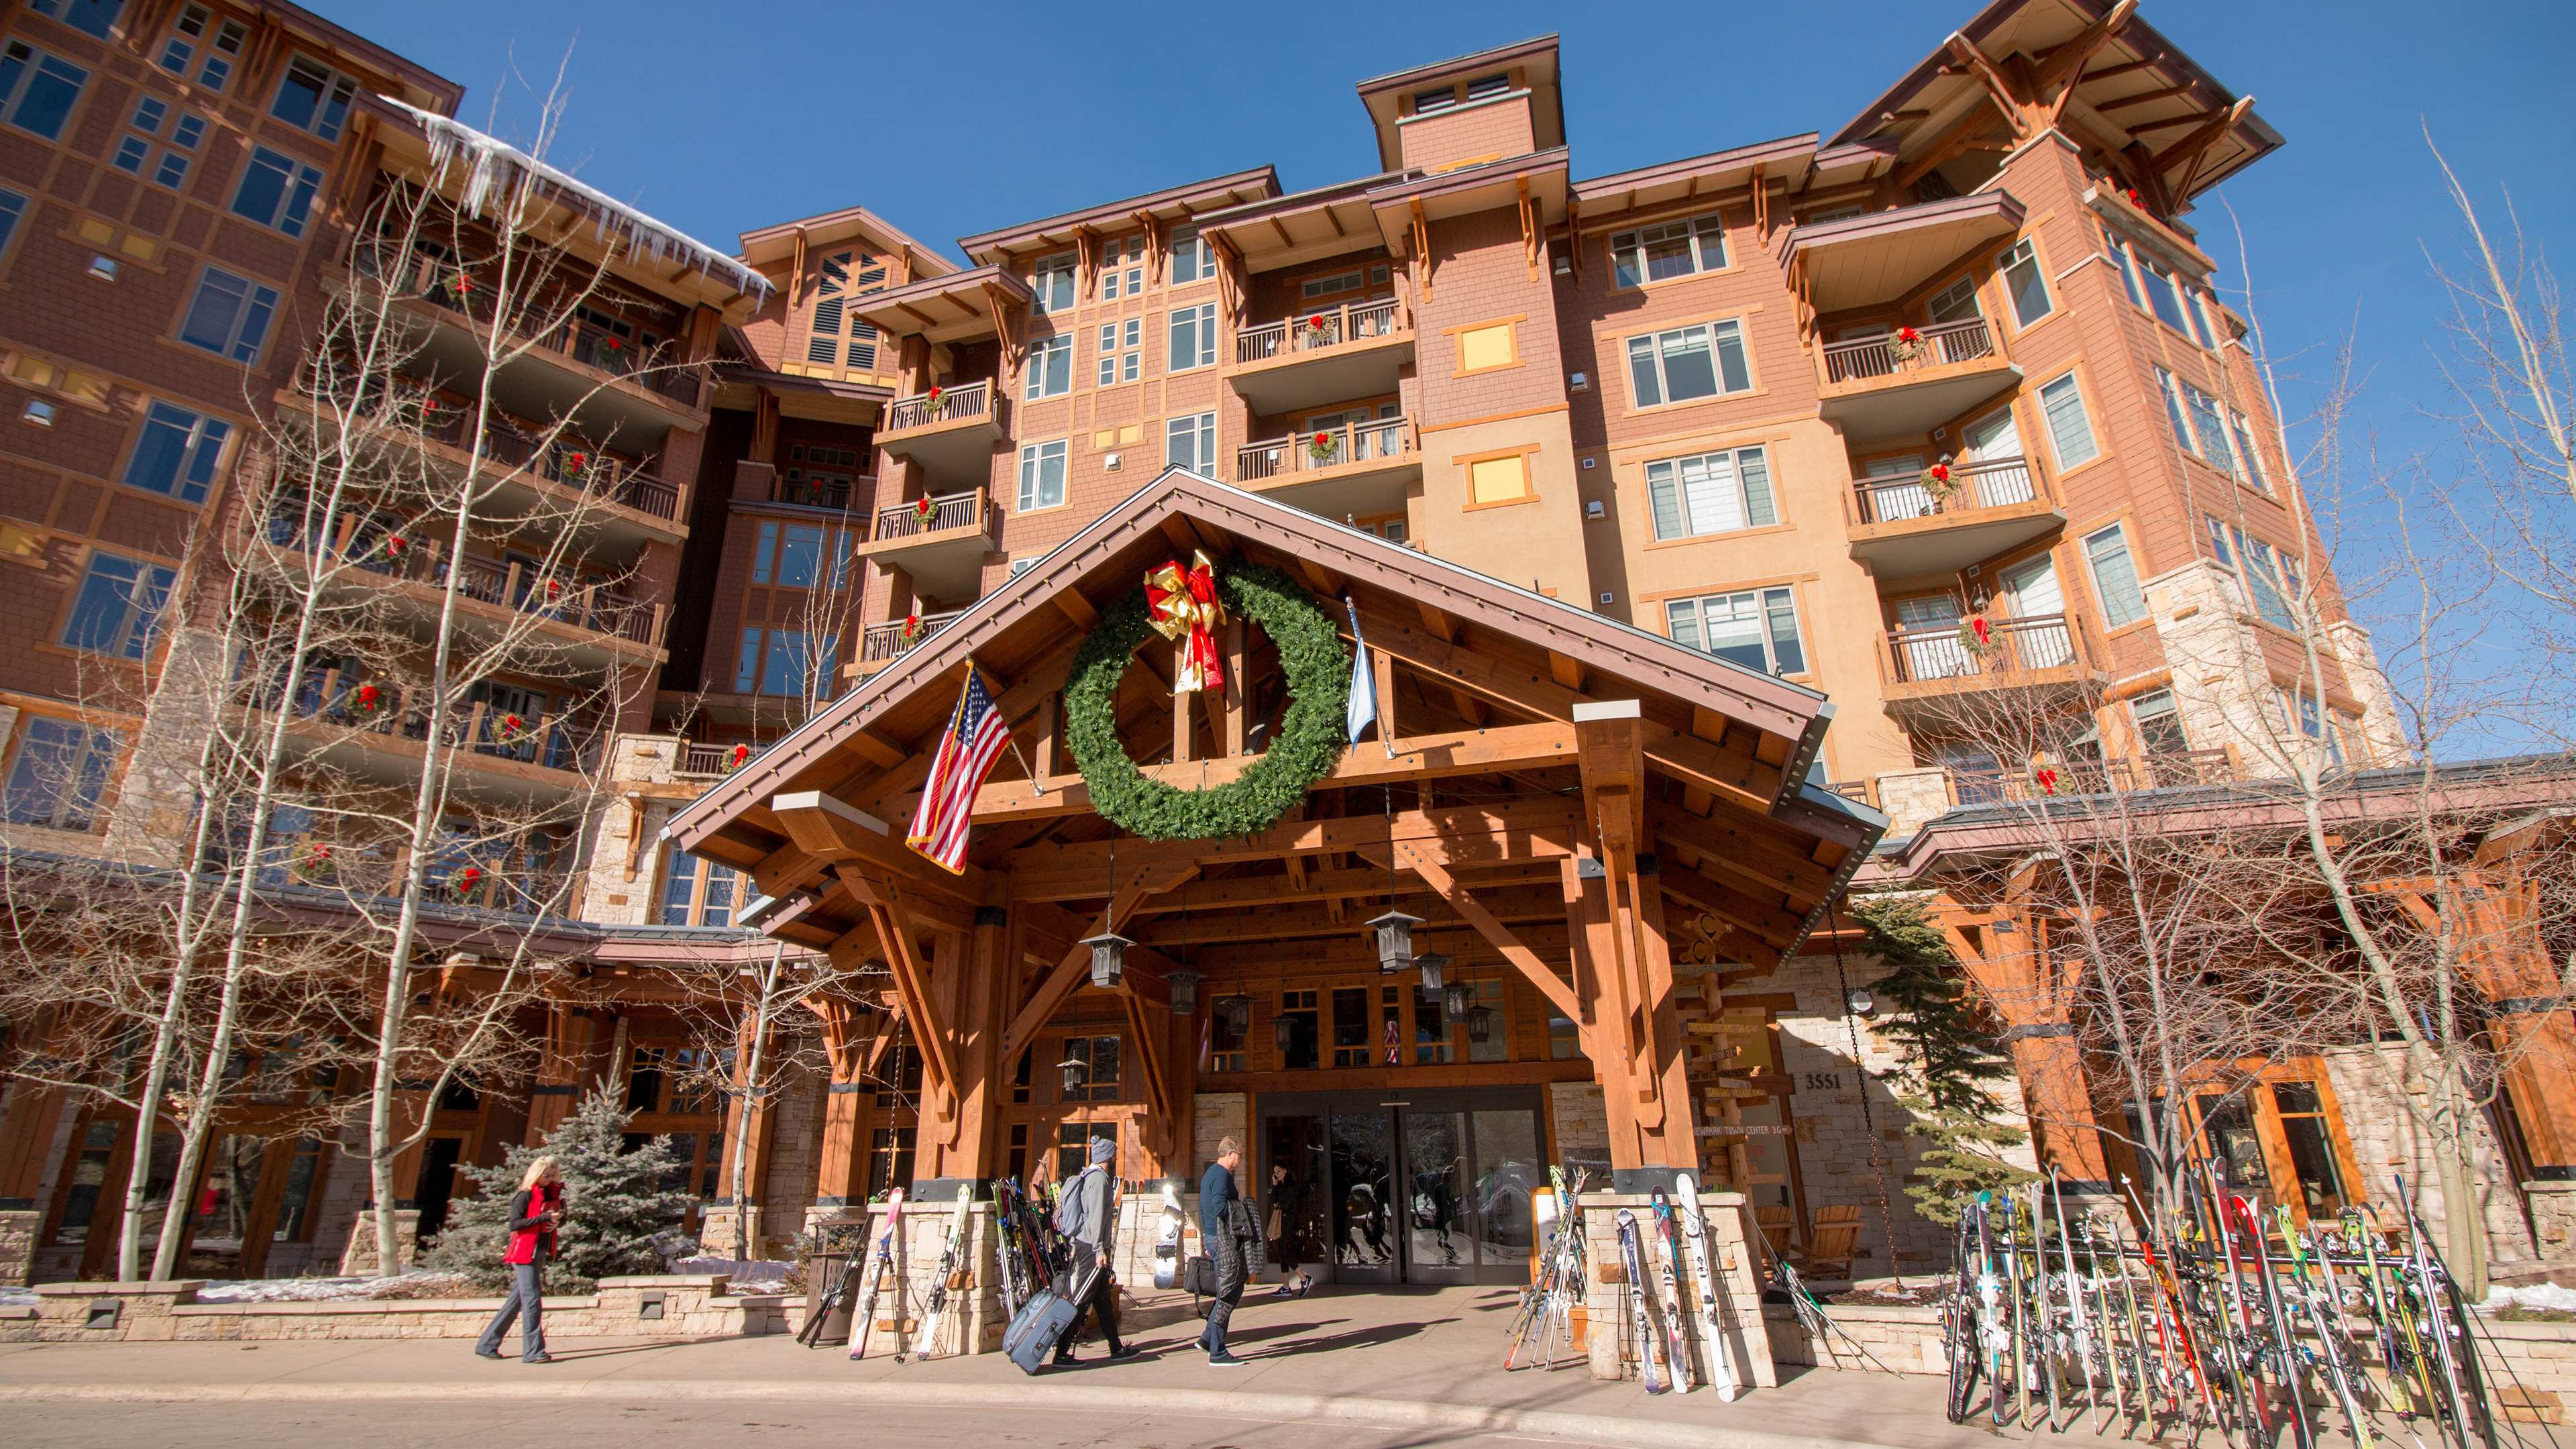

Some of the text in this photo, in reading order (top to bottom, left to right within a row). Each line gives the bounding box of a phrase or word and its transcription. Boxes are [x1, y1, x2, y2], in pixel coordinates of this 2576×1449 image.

[1806, 1074, 1841, 1089] 3551
[1695, 1126, 1722, 1135] EWPARK
[1724, 1126, 1743, 1134] TOWN
[1746, 1126, 1768, 1134] CENTER
